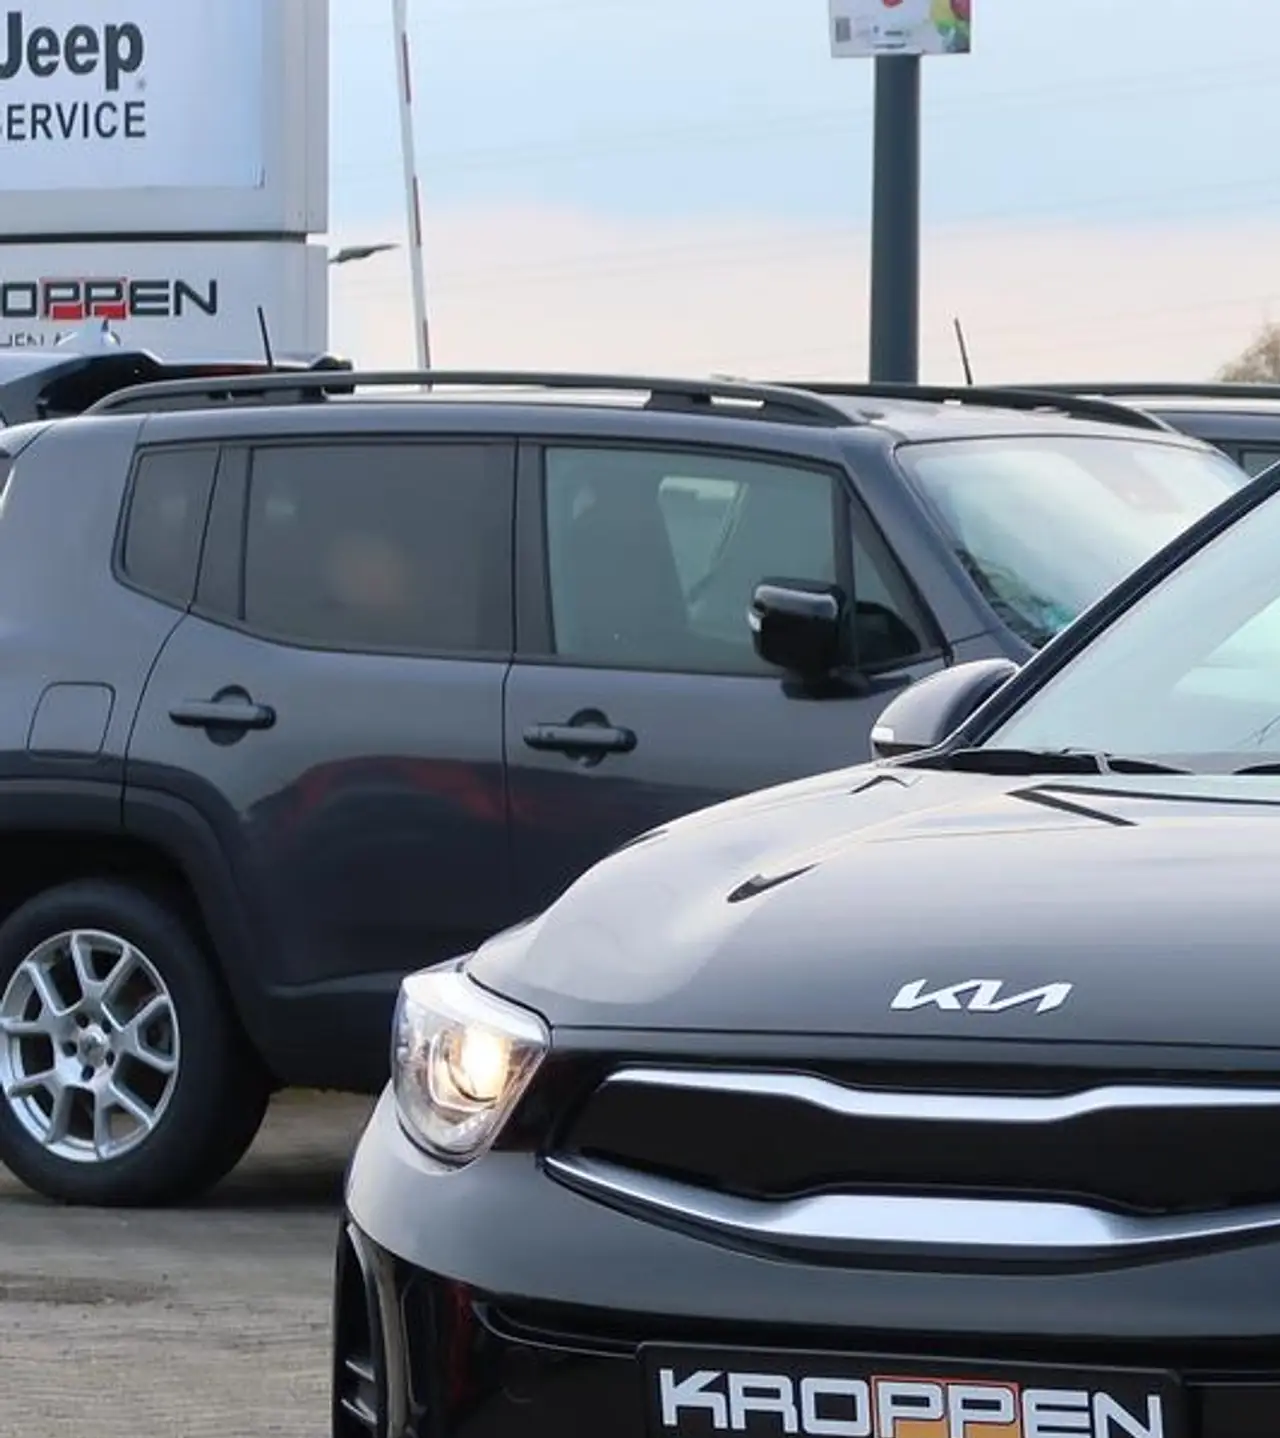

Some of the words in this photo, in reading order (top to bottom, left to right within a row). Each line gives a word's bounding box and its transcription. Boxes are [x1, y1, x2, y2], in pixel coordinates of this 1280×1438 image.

[0, 11, 144, 91] Jeep
[0, 100, 146, 141] ERVICE
[0, 278, 218, 319] OPPEN
[890, 978, 1073, 1013] KIA
